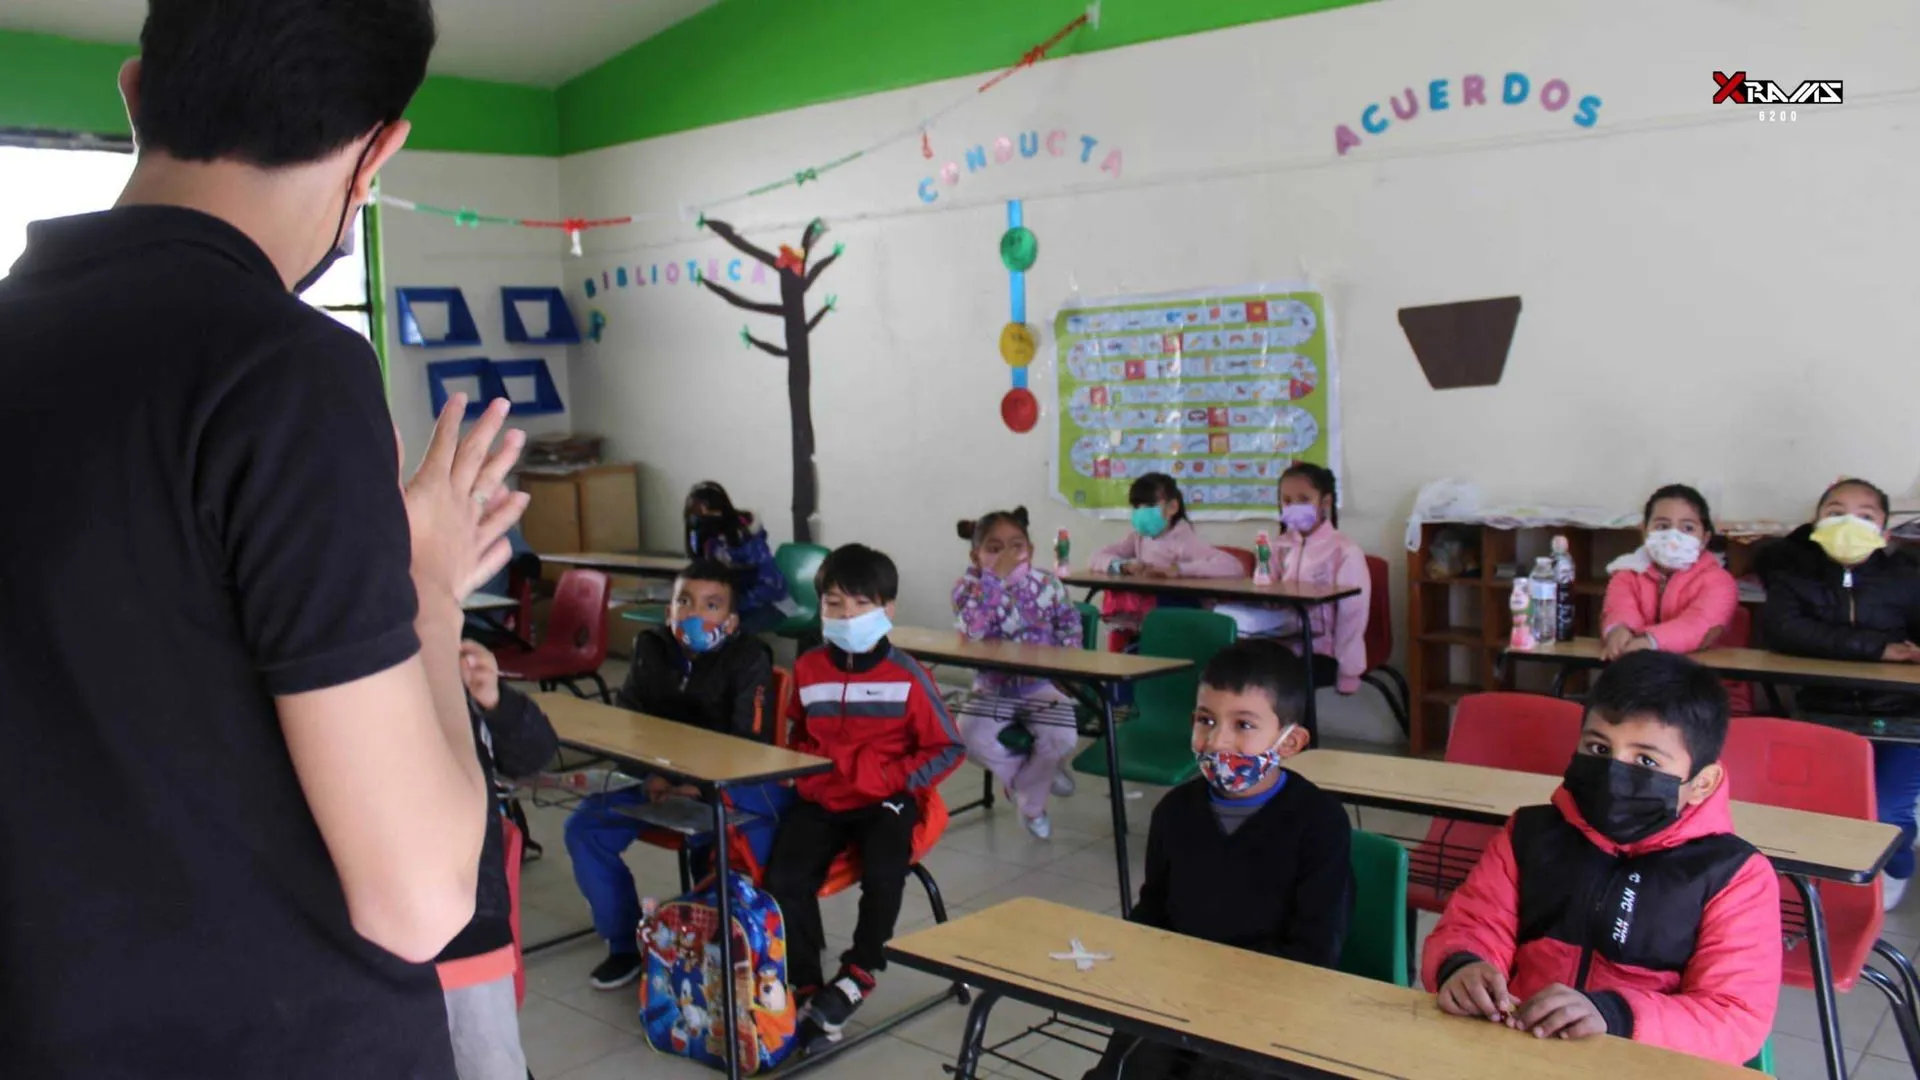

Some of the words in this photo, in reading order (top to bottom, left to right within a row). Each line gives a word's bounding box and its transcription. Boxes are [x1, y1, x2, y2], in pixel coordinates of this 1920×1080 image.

[1334, 72, 1602, 156] ACUERDOS
[918, 130, 1123, 204] CONDUCTA
[584, 259, 766, 299] BIBLIOTECA
[1620, 886, 1636, 912] NYC
